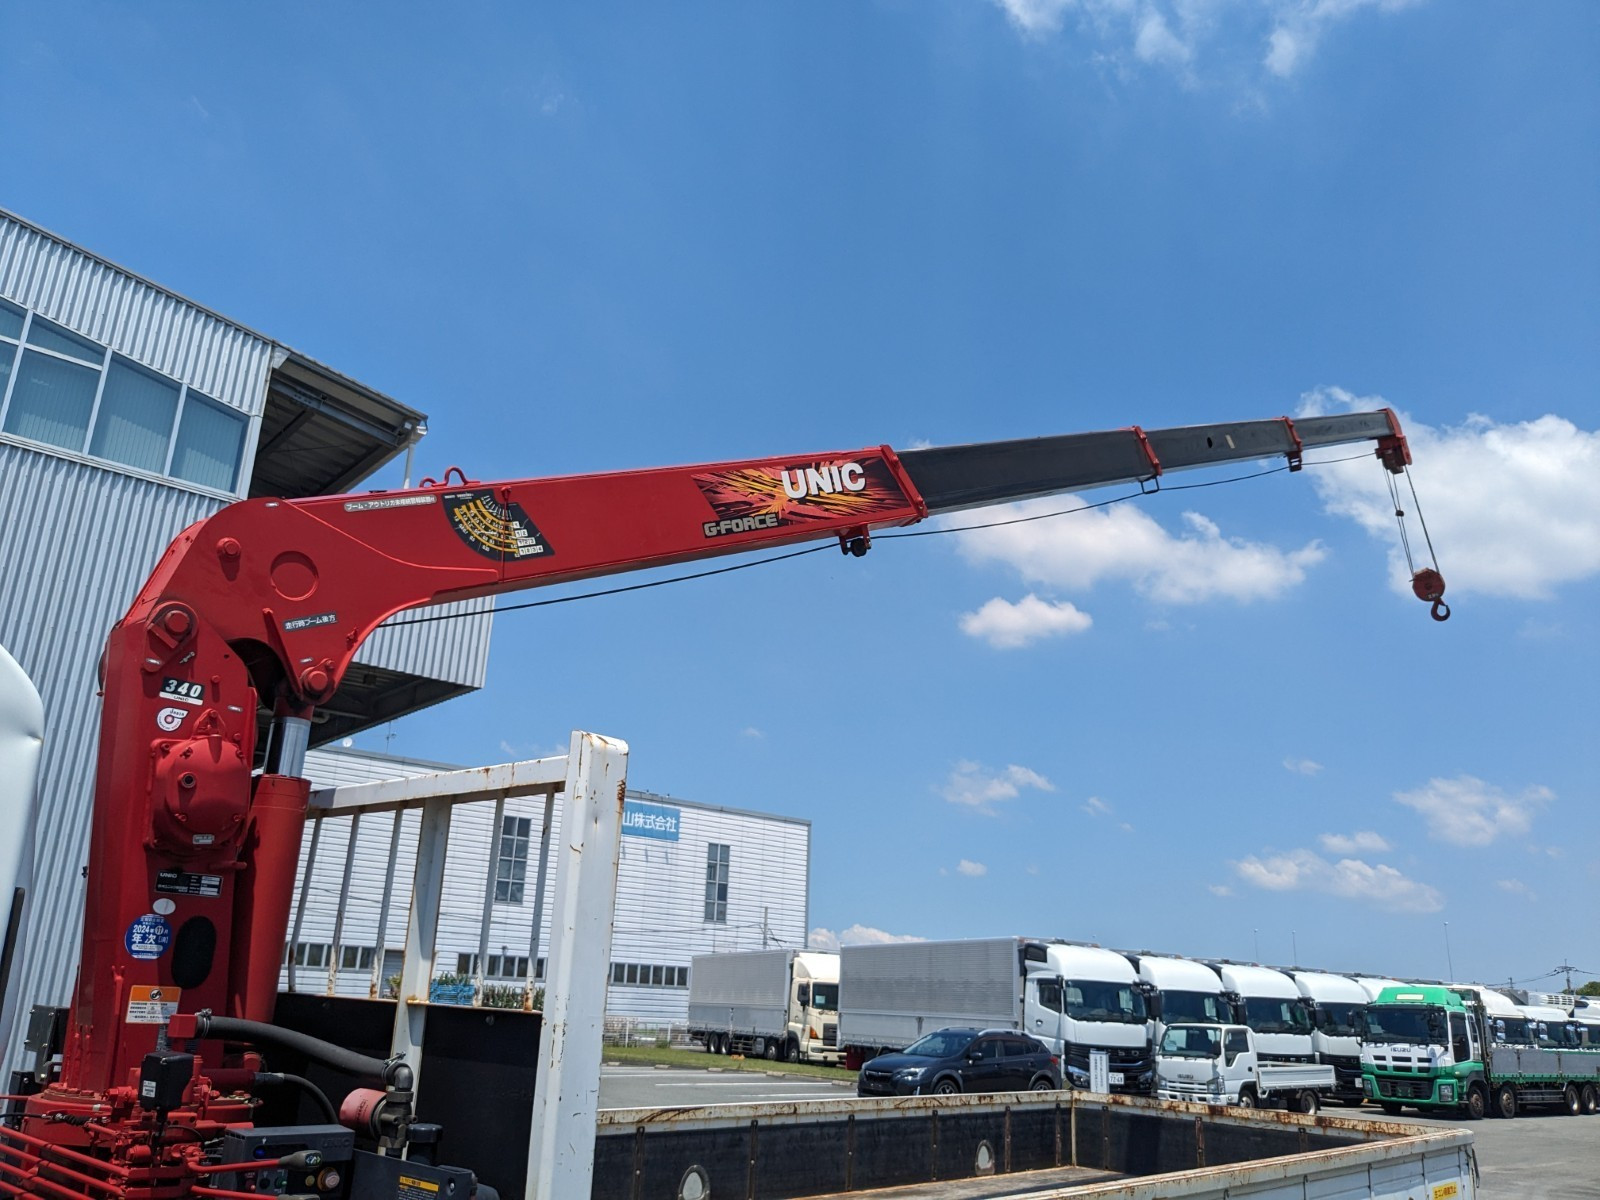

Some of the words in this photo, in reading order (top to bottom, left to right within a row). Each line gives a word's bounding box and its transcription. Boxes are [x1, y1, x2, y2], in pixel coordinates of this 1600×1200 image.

[780, 462, 866, 499] UNIC
[165, 679, 202, 698] 340
[622, 810, 678, 832] 山株式会社
